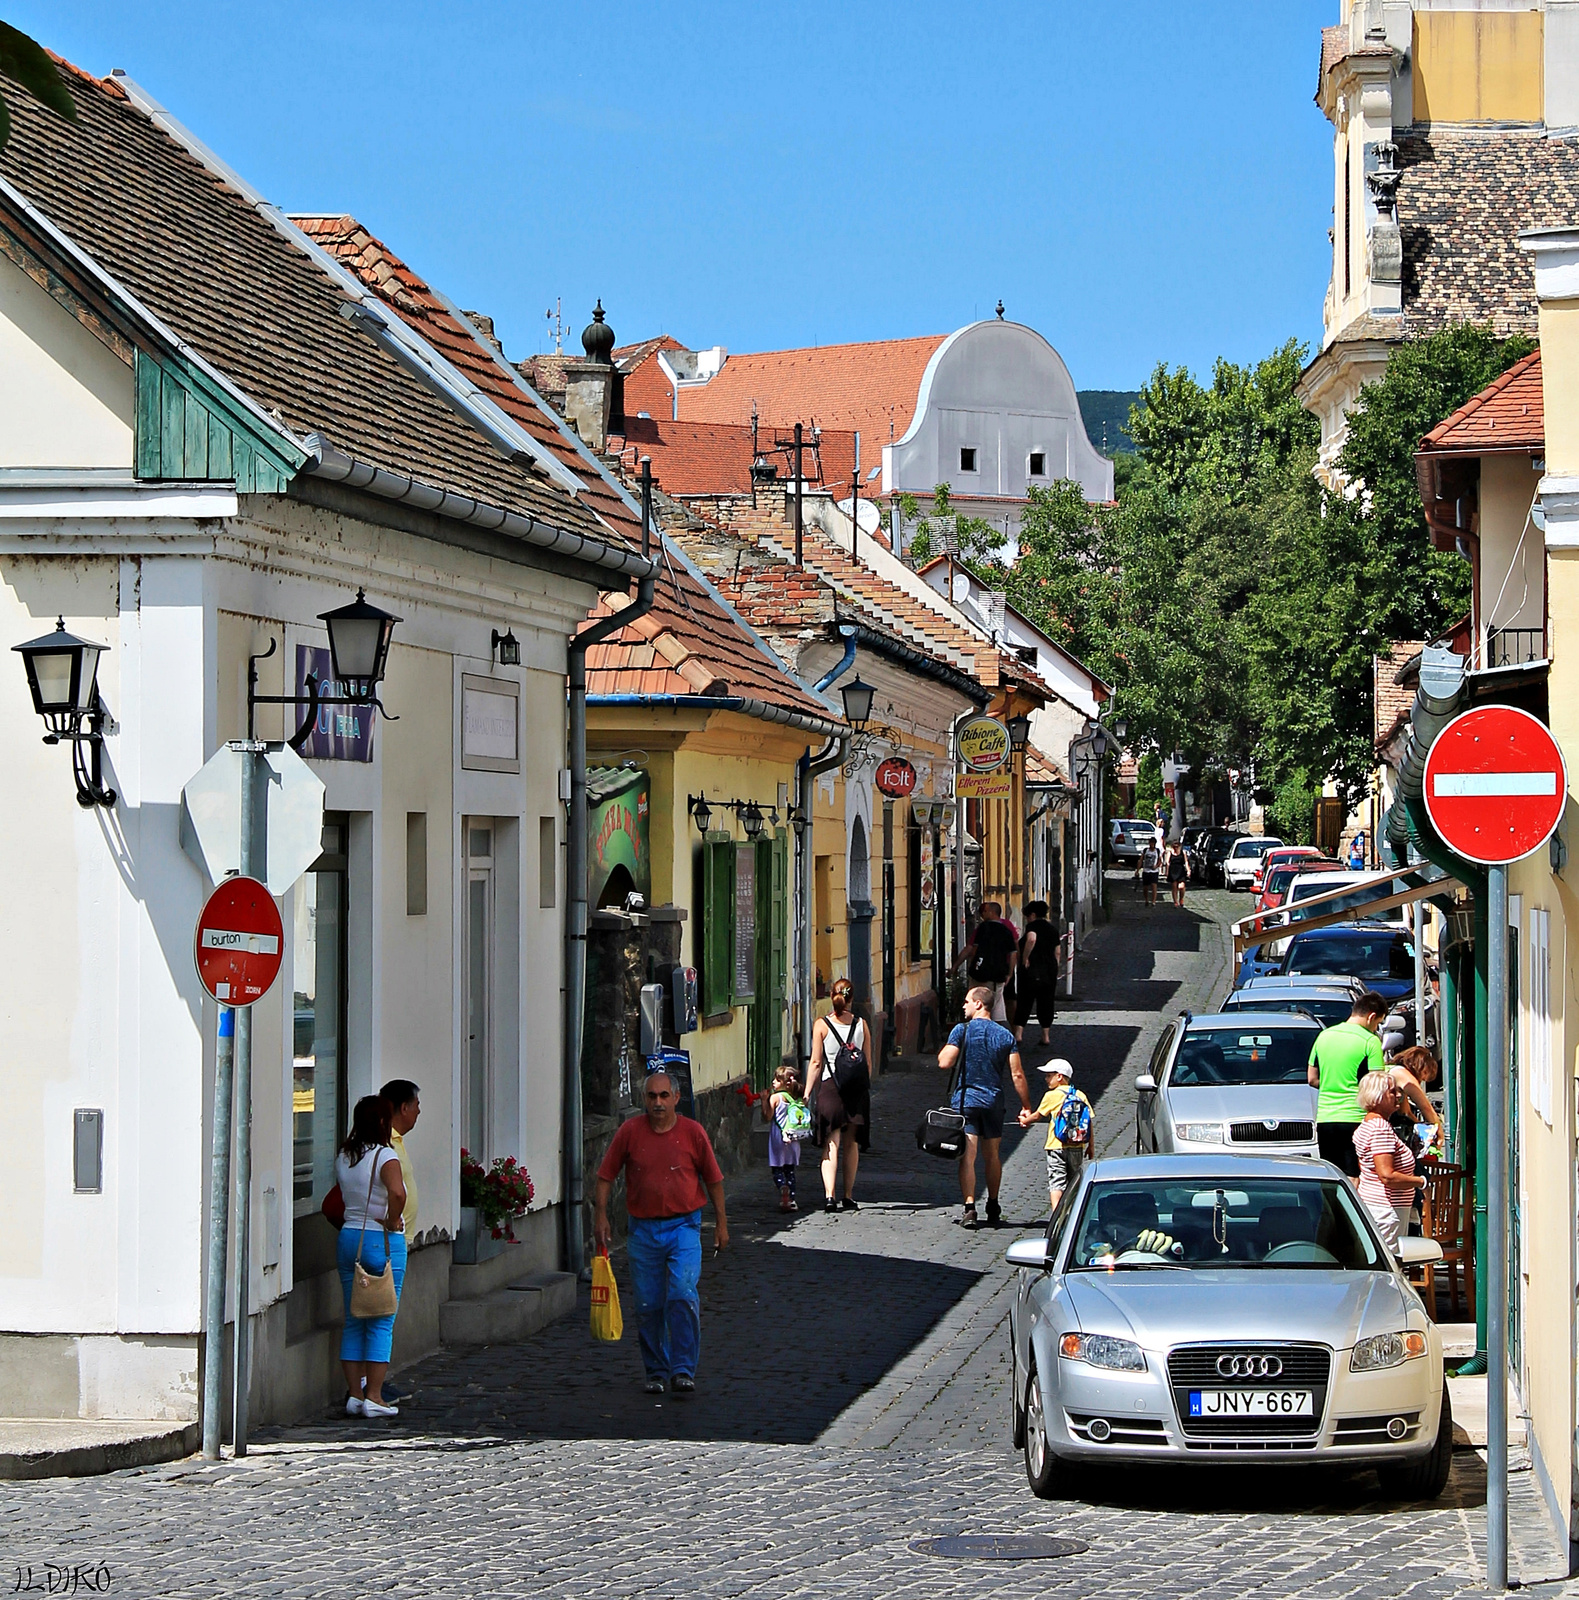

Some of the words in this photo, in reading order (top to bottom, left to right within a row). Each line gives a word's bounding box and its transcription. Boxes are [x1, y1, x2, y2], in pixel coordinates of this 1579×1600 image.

[961, 728, 999, 742] Bibione
[884, 769, 909, 786] folt
[596, 804, 622, 866] PIZZA
[211, 933, 241, 946] burton
[1192, 1404, 1199, 1412] H
[1207, 1392, 1307, 1412] JNY-667
